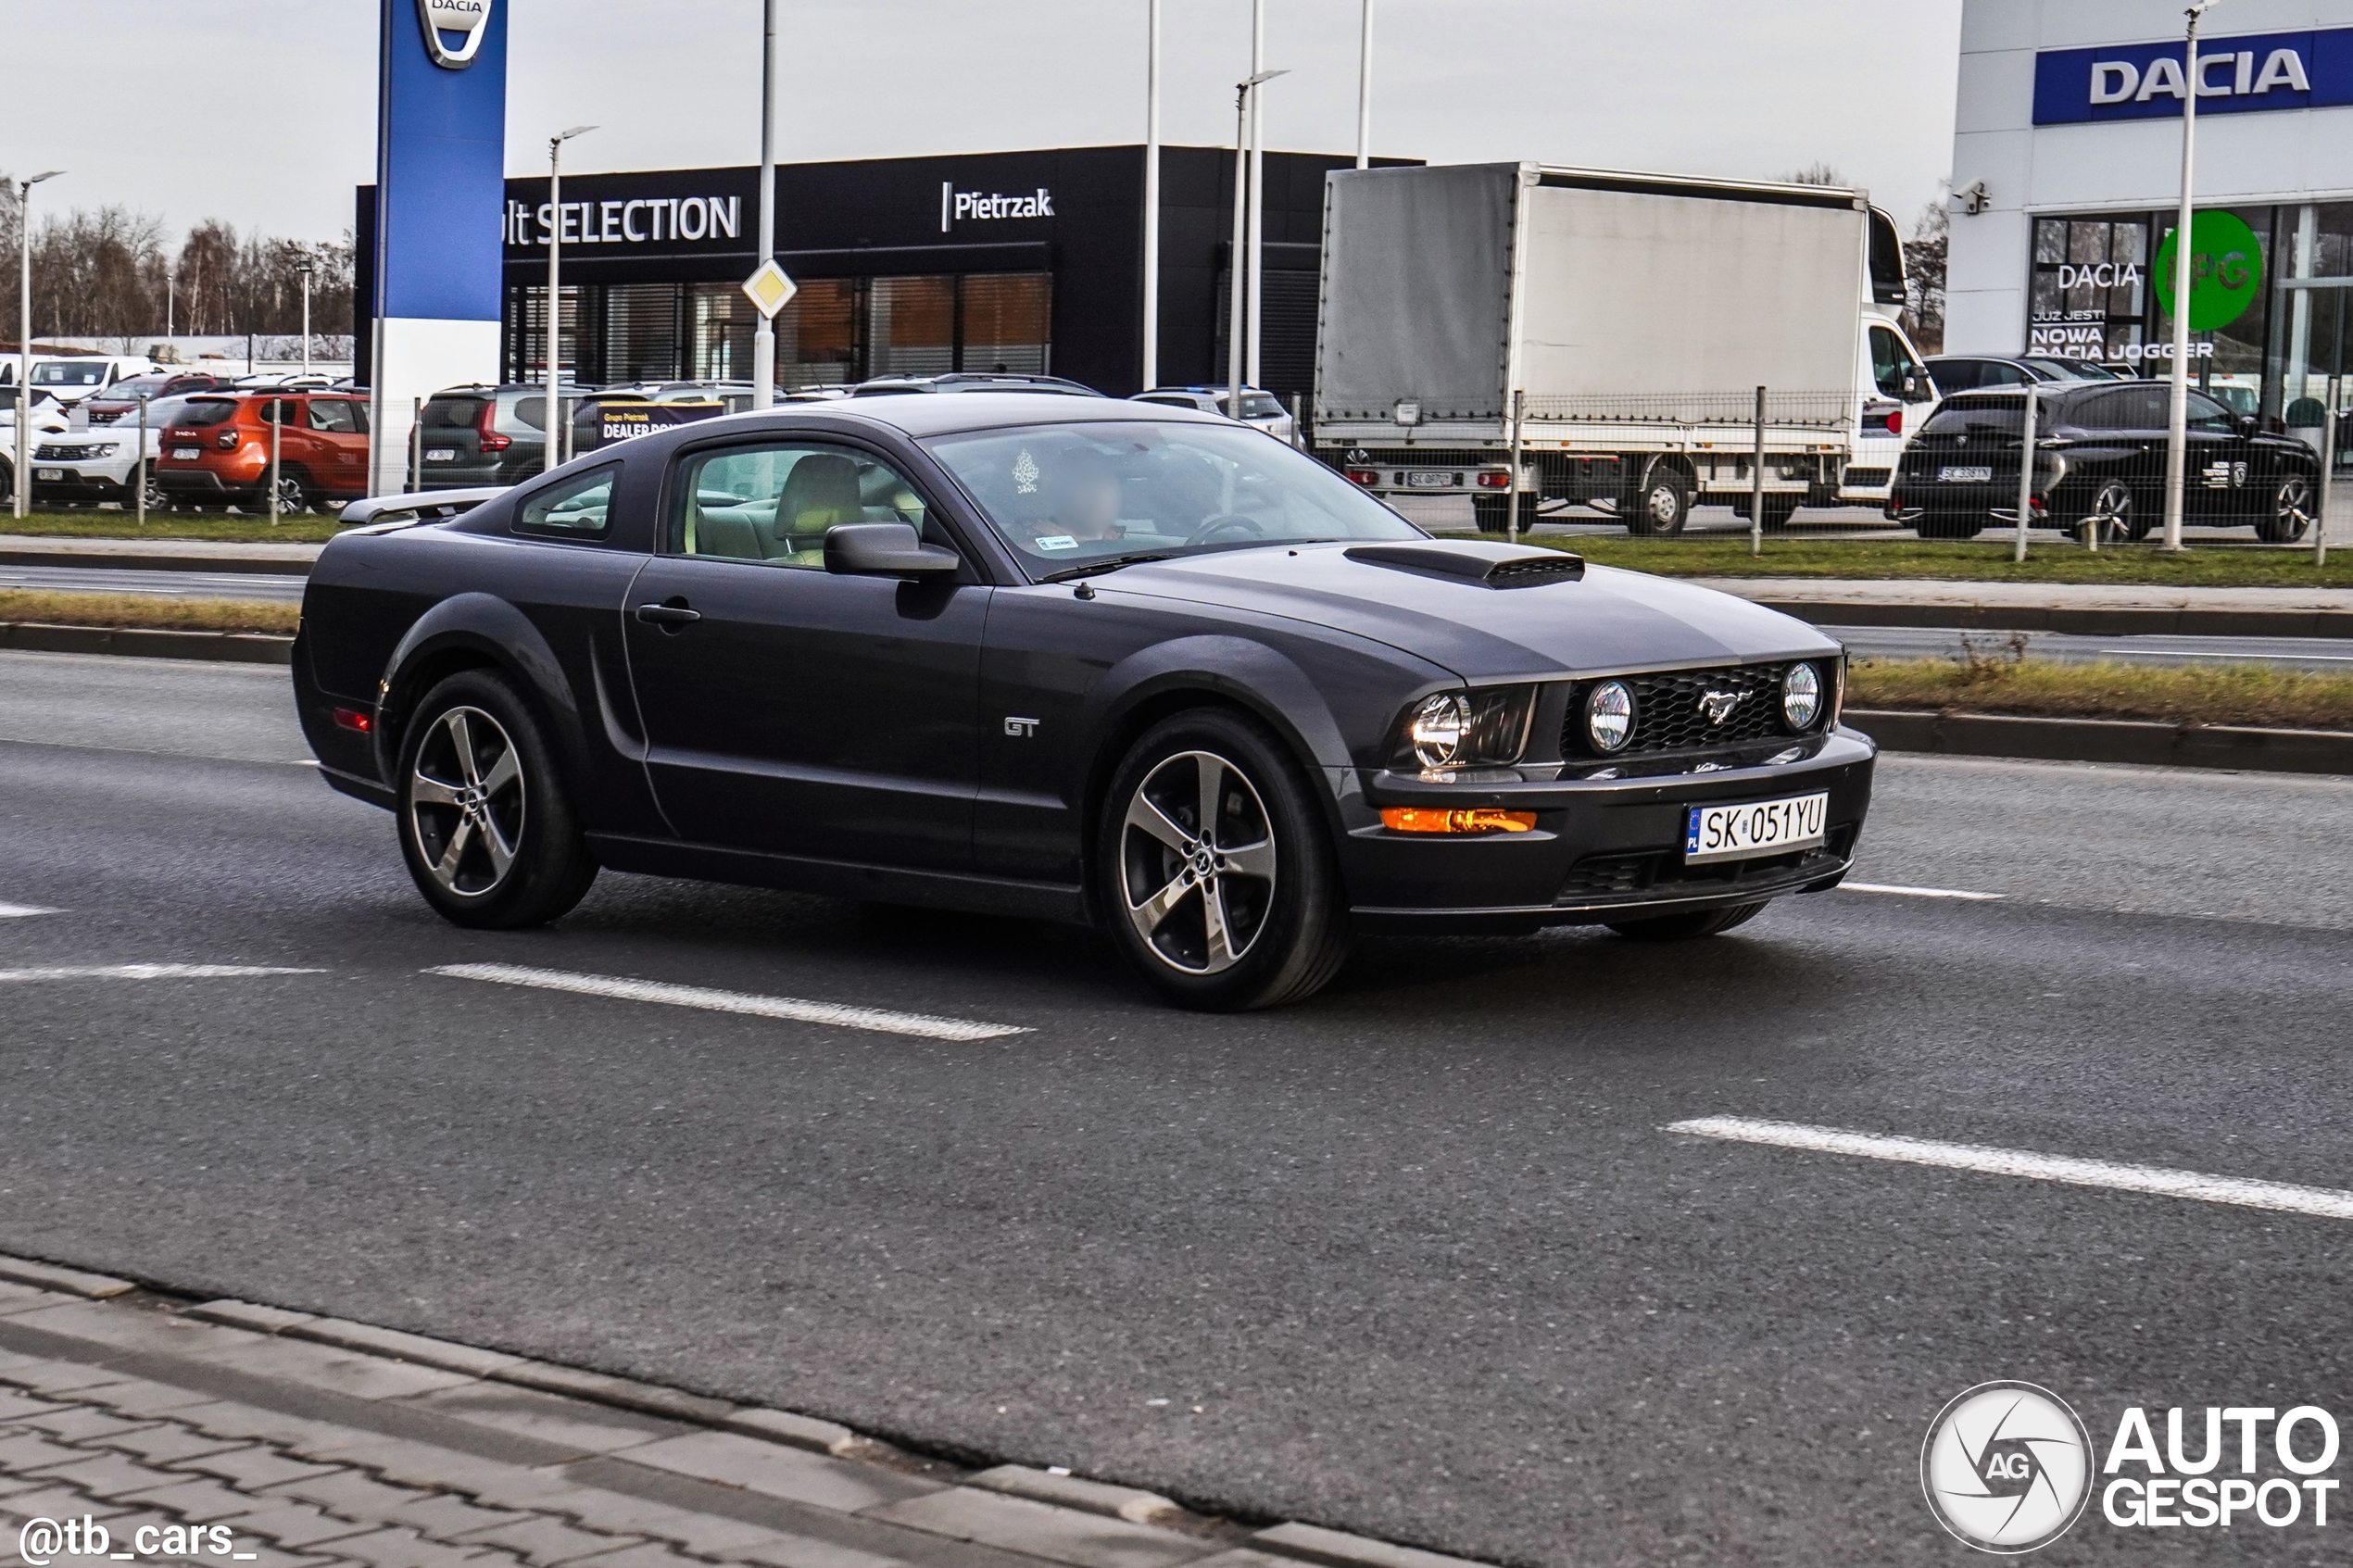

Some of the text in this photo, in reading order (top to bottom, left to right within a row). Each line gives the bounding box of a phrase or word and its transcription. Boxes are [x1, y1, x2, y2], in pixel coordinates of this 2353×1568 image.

[432, 0, 483, 13] DACIA
[2090, 48, 2310, 104] DACIA
[954, 188, 1055, 220] Pietrzak
[536, 196, 740, 245] SELECTION
[2058, 262, 2140, 289] DACIA
[2064, 309, 2106, 320] JEST!
[2031, 327, 2104, 344] NOWA
[2109, 342, 2214, 360] JOGGER
[603, 423, 649, 438] DEALER
[1004, 717, 1040, 737] GT
[1706, 797, 1823, 848] SK 051YU
[1688, 837, 1698, 848] PL
